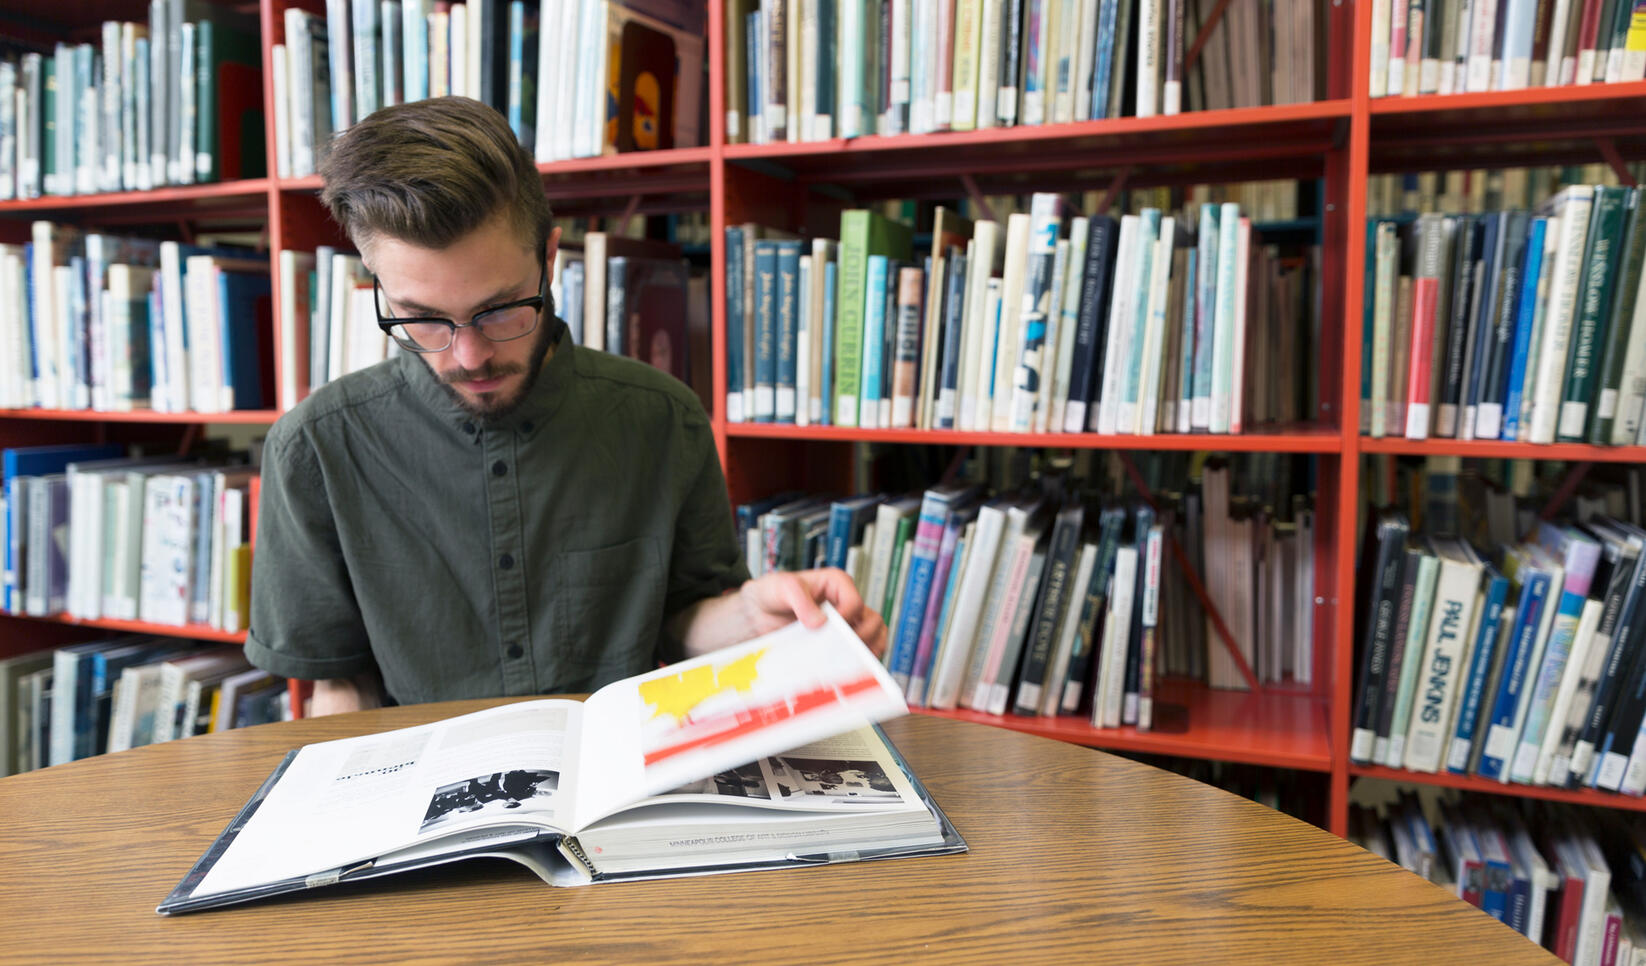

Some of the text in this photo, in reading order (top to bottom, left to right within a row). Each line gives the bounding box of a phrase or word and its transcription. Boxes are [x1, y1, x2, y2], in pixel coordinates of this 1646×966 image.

[841, 245, 861, 394] JOHN CURRIN
[1573, 238, 1609, 379] WINSLOW HOMER
[1045, 559, 1066, 619] ARTHUR
[1033, 620, 1054, 663] DOVE
[1421, 599, 1463, 724] PAUL JENKINS
[669, 838, 713, 848] MINNEAPOLIS
[714, 835, 745, 844] COLLEGE
